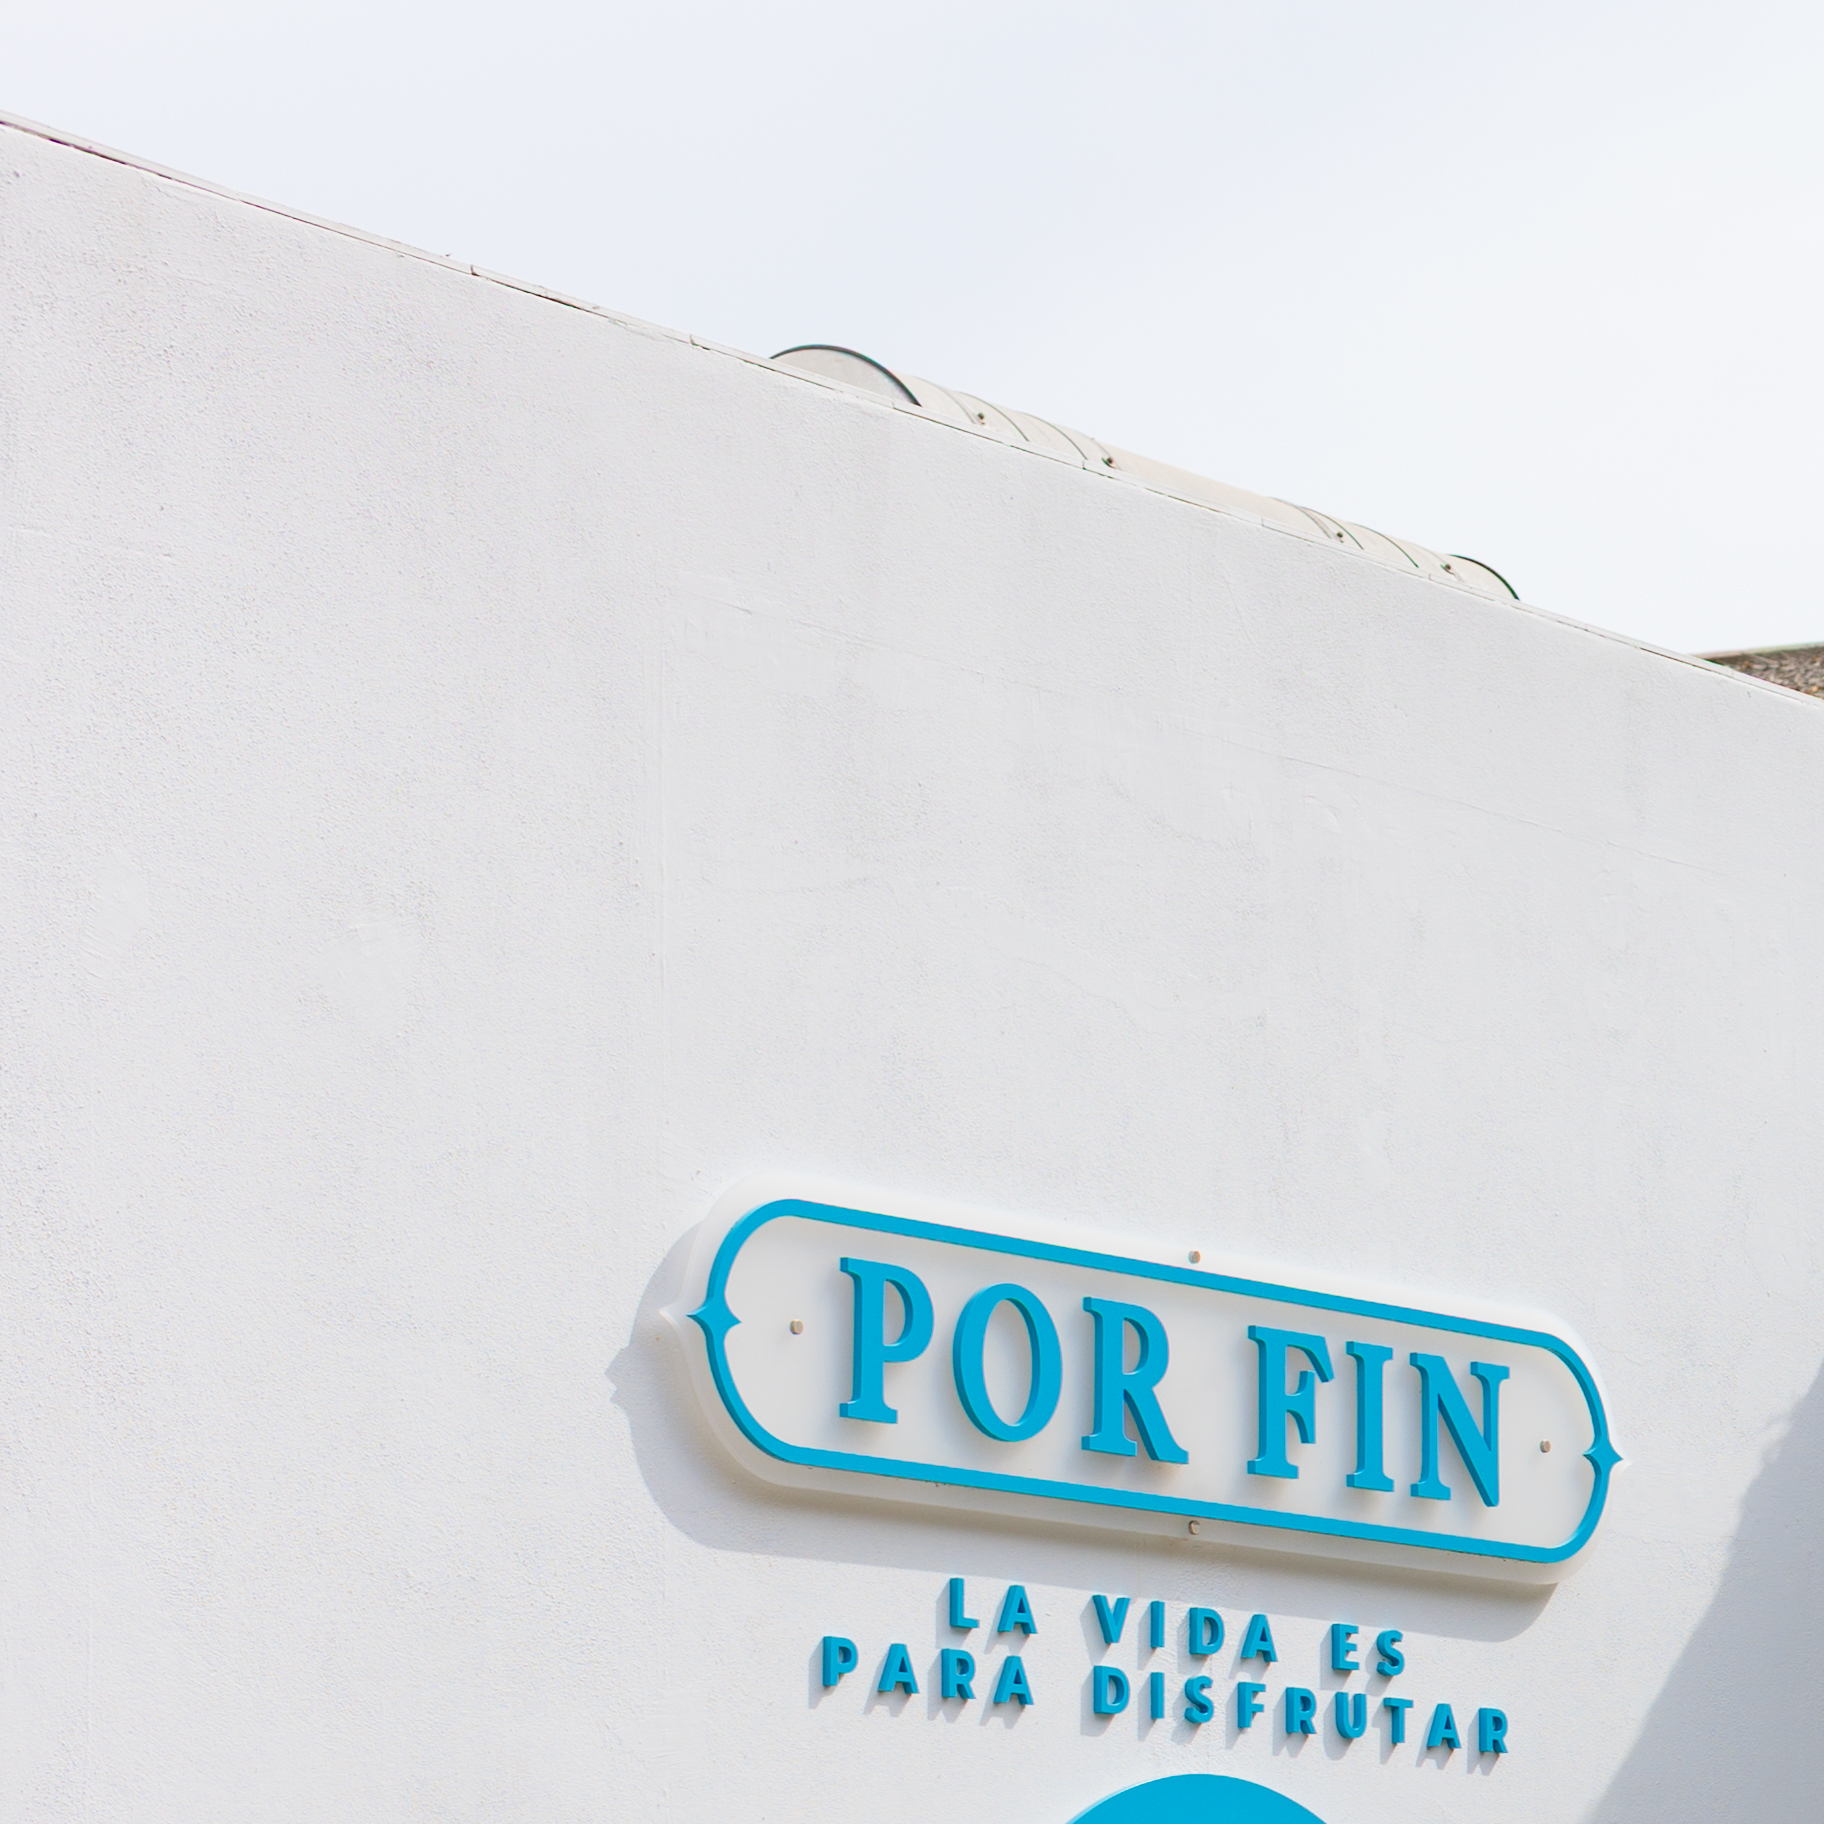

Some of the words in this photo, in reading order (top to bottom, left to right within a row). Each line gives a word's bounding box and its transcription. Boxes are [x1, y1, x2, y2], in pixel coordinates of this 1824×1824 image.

[838, 1256, 1189, 1466] POR
[1245, 1324, 1510, 1508] FIN
[948, 1576, 1038, 1635] LA
[1091, 1593, 1279, 1666] VIDA
[1330, 1621, 1405, 1678] ES
[821, 1634, 1035, 1707] PARA
[1092, 1664, 1509, 1755] DISFRUTAR
